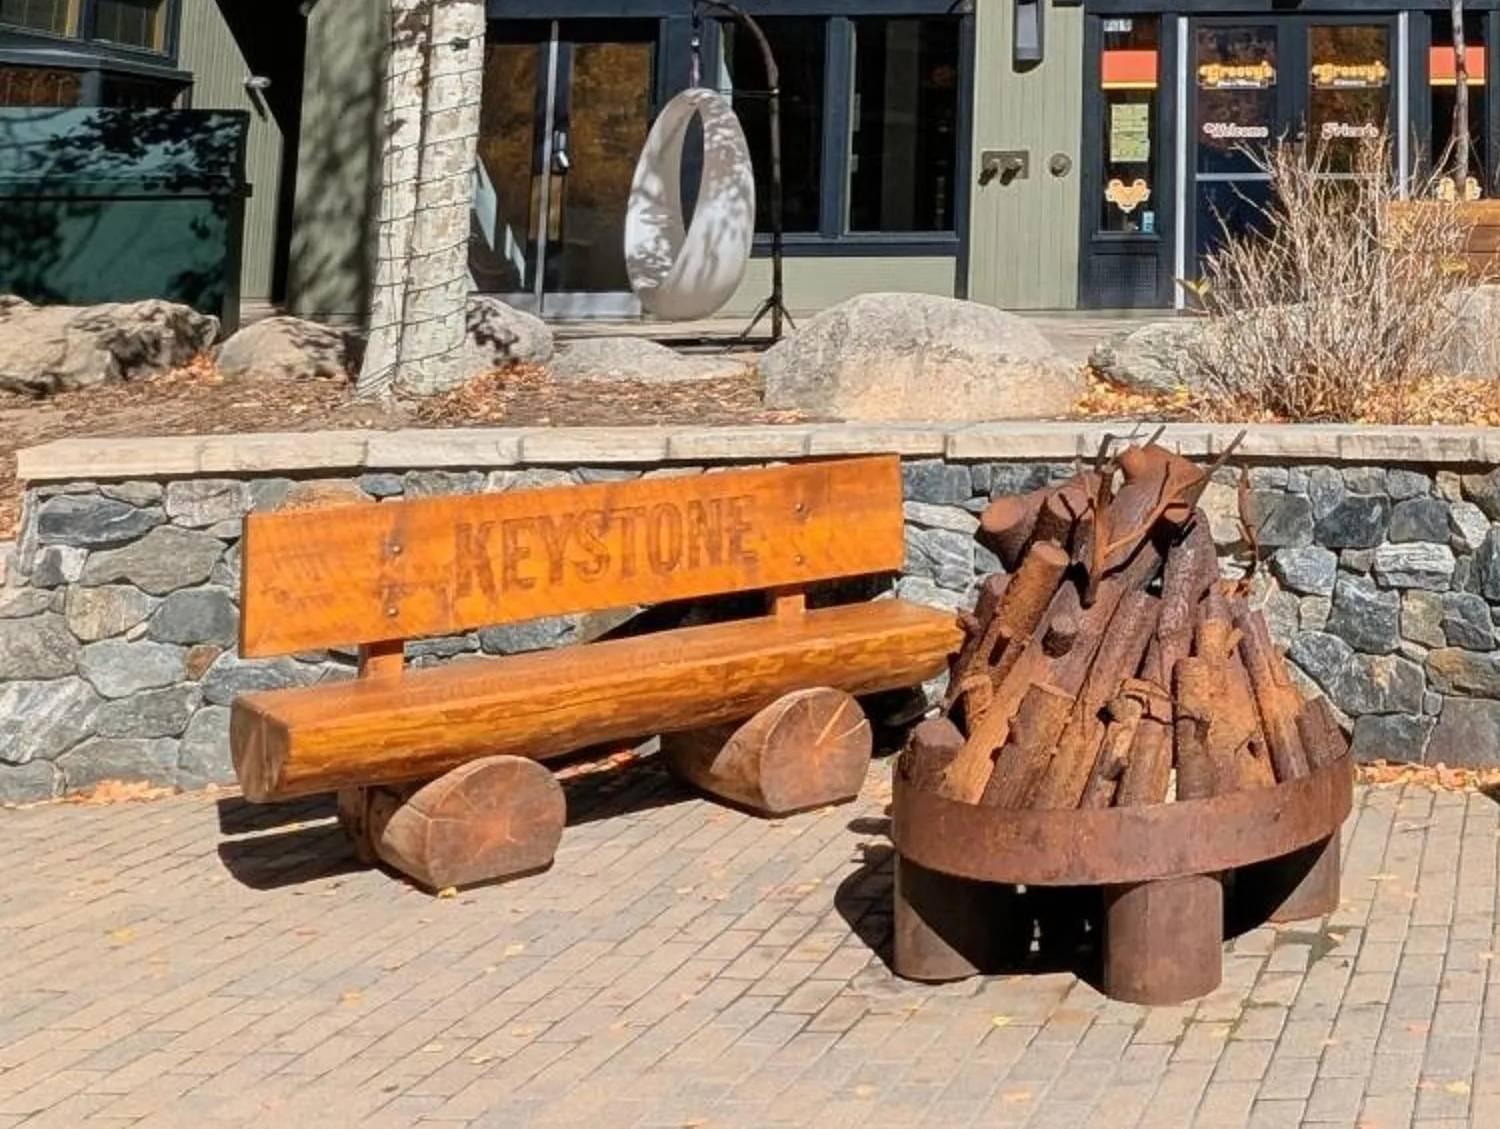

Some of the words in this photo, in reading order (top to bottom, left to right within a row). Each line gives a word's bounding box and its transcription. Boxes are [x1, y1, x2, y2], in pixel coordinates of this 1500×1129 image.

[1200, 60, 1274, 84] Groovy's
[1312, 60, 1387, 84] Groovy's
[1203, 122, 1269, 138] Welcome
[453, 497, 757, 596] KEYSTONE
